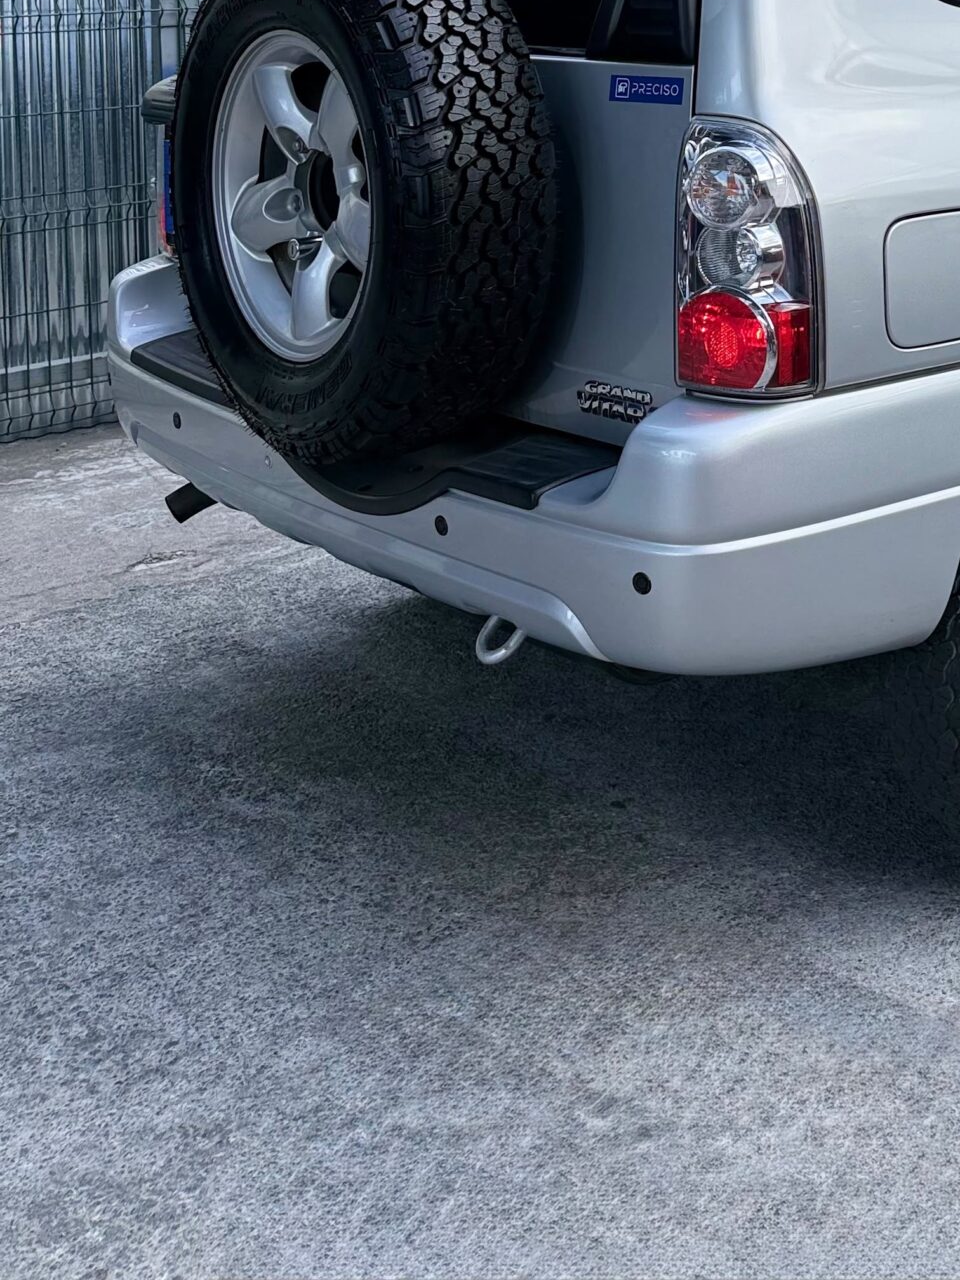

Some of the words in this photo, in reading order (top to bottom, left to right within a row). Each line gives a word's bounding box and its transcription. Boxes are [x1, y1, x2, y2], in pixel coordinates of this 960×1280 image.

[631, 82, 680, 97] PRECISO
[584, 380, 652, 406] GRAND
[577, 390, 656, 425] VITAR
